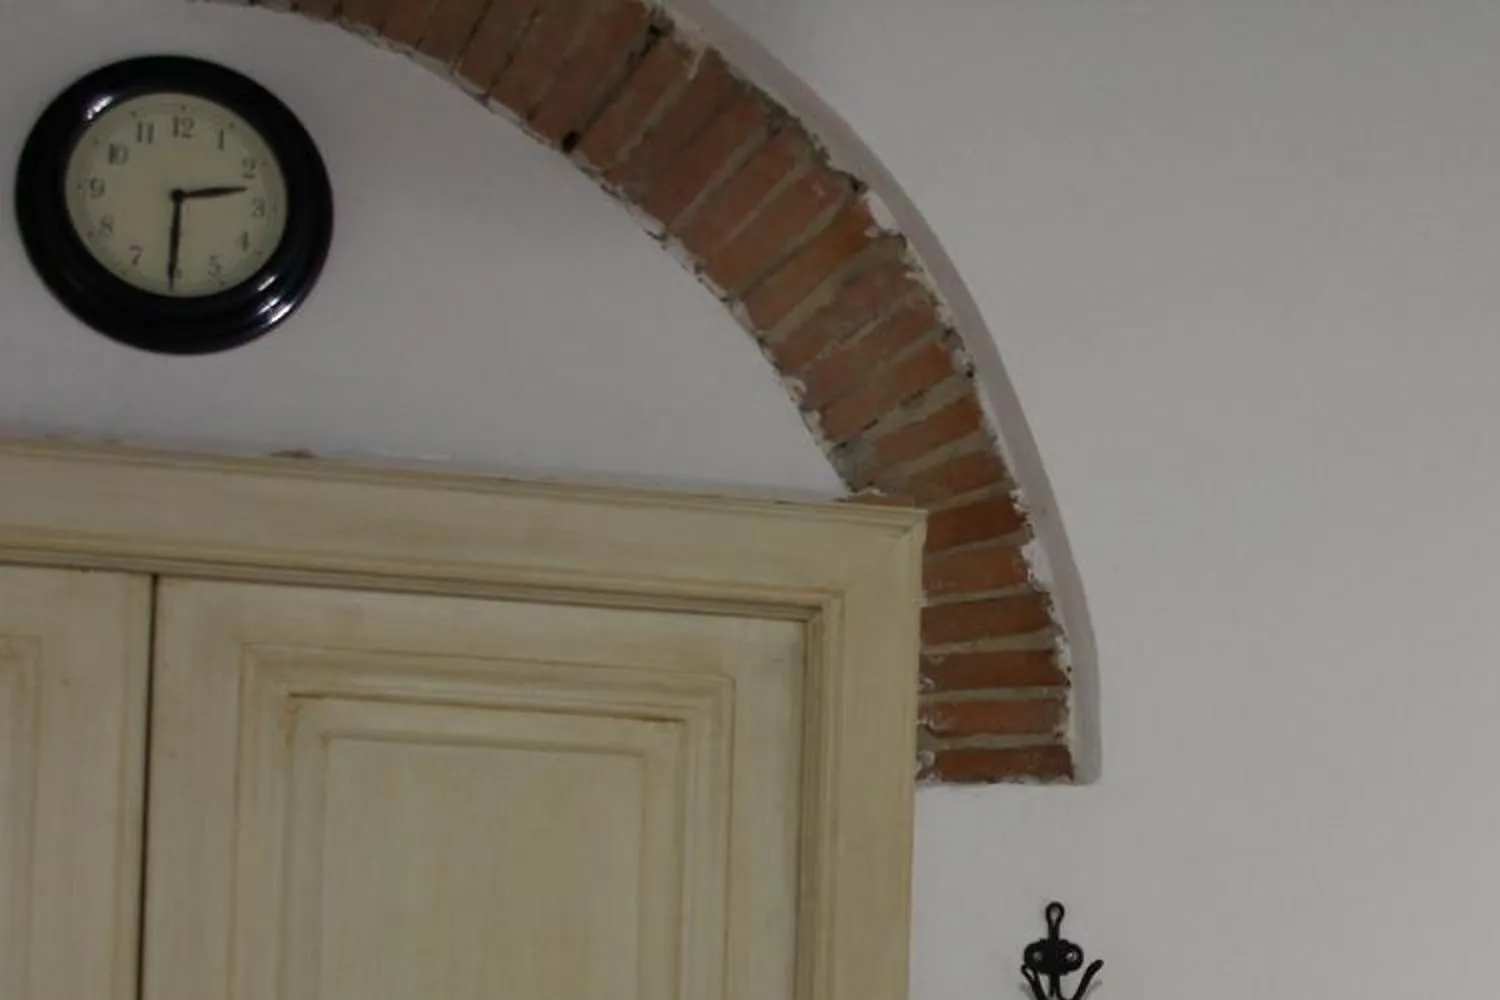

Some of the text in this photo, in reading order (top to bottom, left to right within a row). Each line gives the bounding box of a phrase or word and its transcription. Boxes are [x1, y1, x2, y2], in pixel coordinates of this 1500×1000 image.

[136, 122, 154, 145] 11
[172, 115, 195, 139] 12
[217, 127, 225, 151] 1
[107, 143, 129, 165] 10
[242, 157, 257, 179] 2
[90, 177, 105, 199] 9
[252, 198, 265, 218] 3
[99, 216, 114, 237] 8
[237, 231, 250, 252] 4
[129, 245, 143, 266] 7
[208, 255, 222, 278] 5
